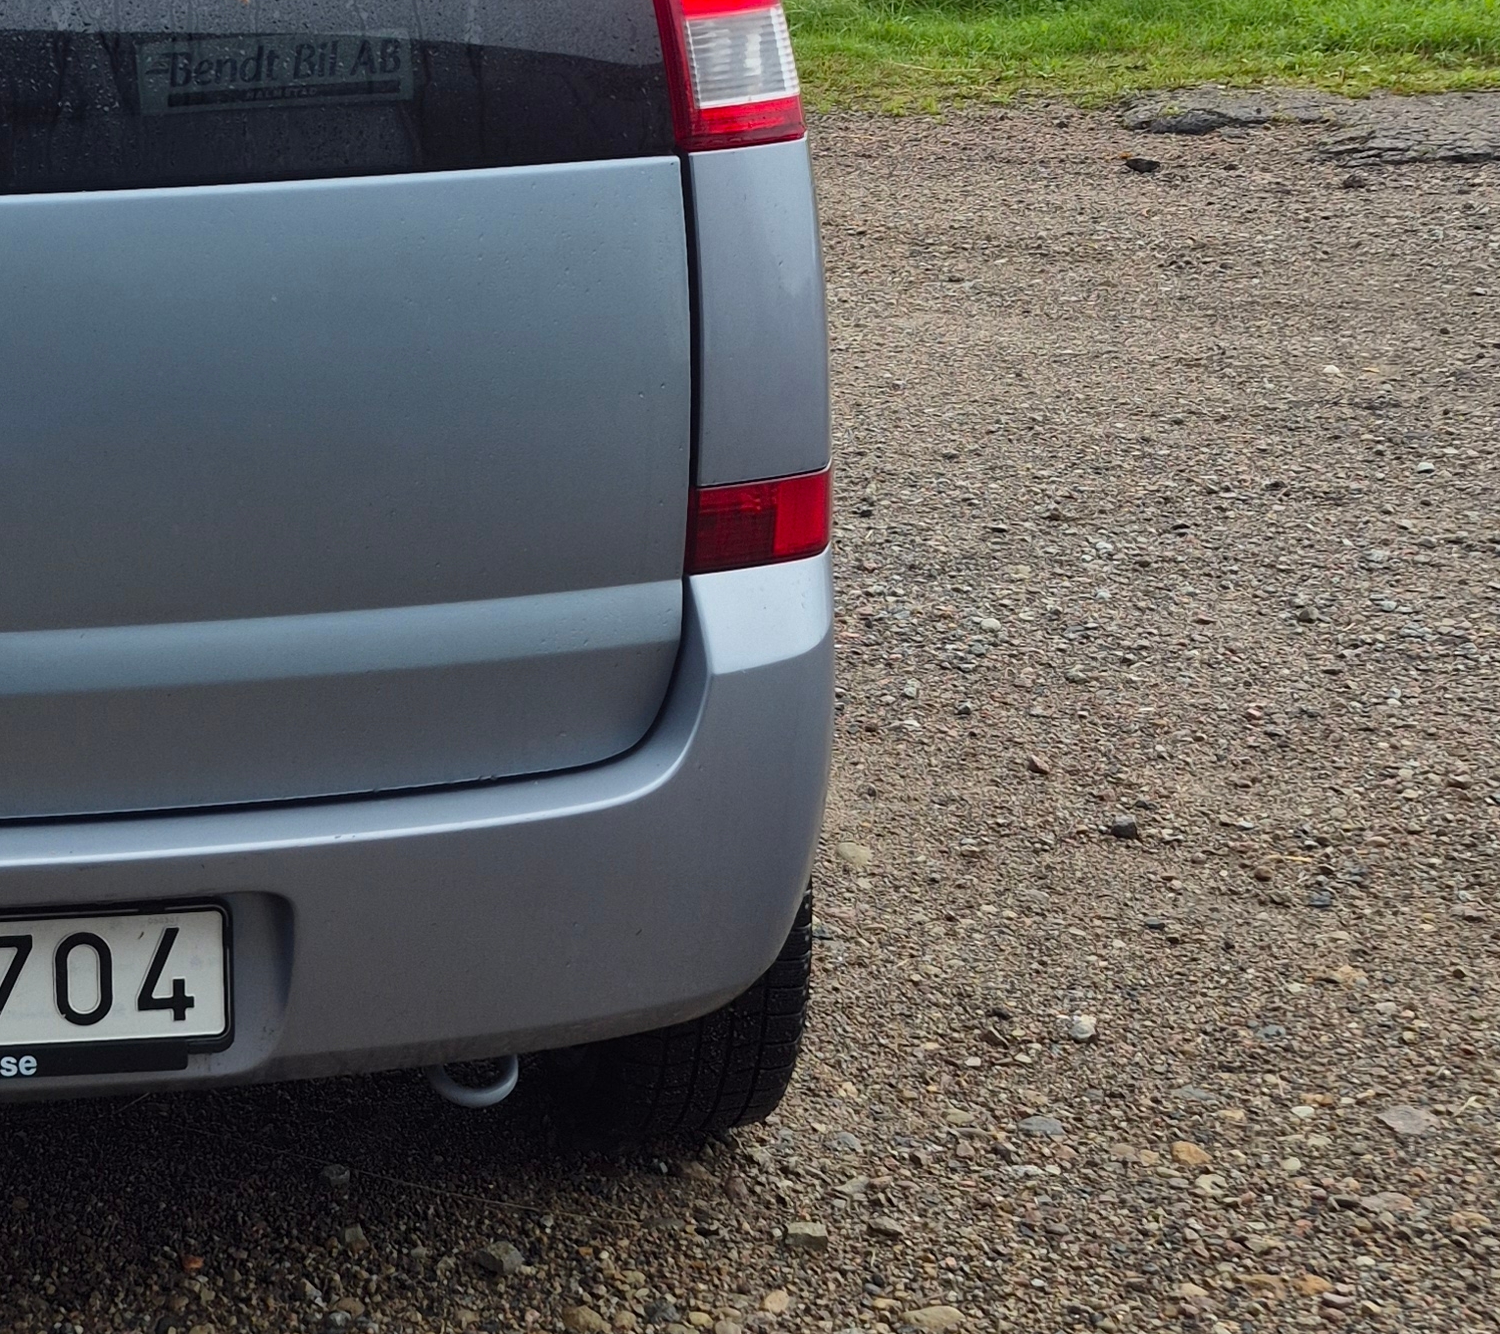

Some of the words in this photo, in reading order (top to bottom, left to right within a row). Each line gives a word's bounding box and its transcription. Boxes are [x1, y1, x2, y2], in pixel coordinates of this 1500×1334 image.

[162, 44, 280, 88] Bendt
[293, 40, 338, 79] Bil
[350, 38, 401, 77] AB
